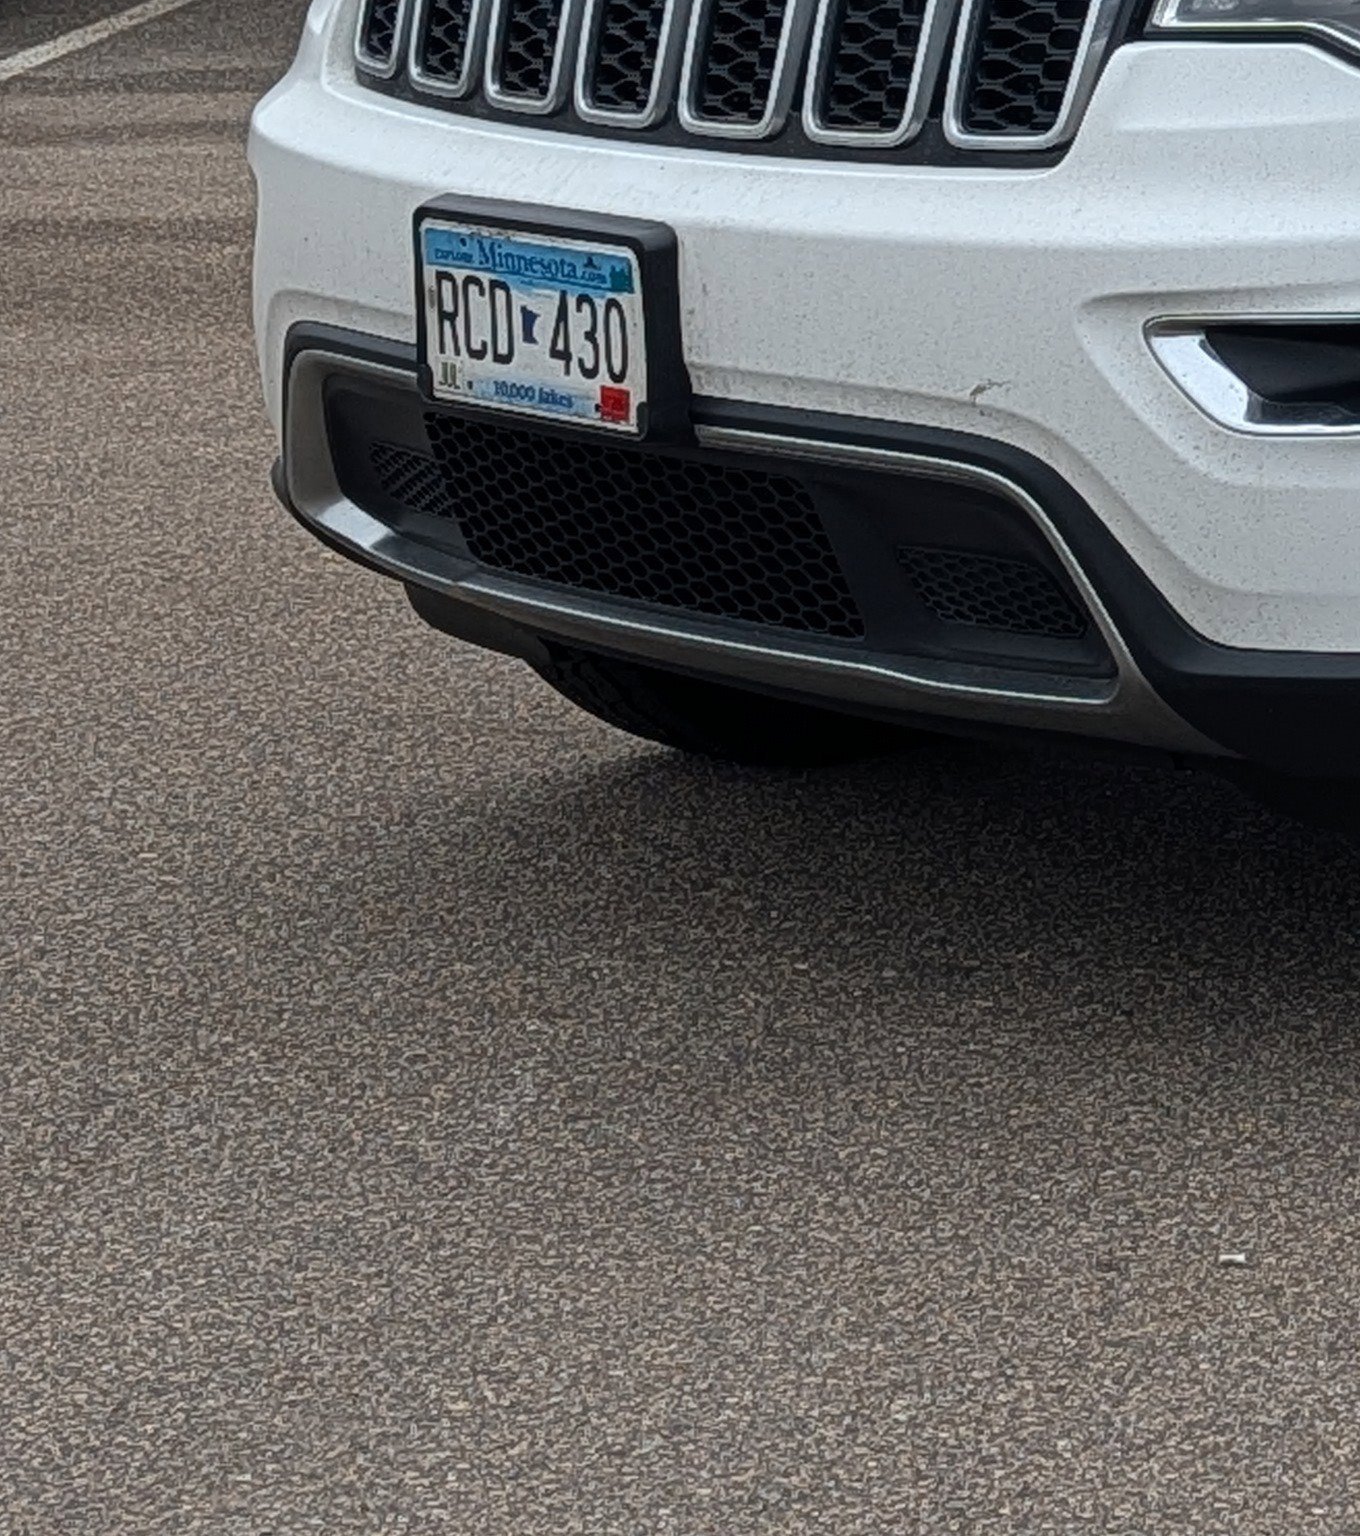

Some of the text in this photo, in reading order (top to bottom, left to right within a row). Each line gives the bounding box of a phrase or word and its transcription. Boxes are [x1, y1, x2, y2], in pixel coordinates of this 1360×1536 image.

[435, 270, 629, 384] RCD 430
[538, 387, 574, 409] lakes
